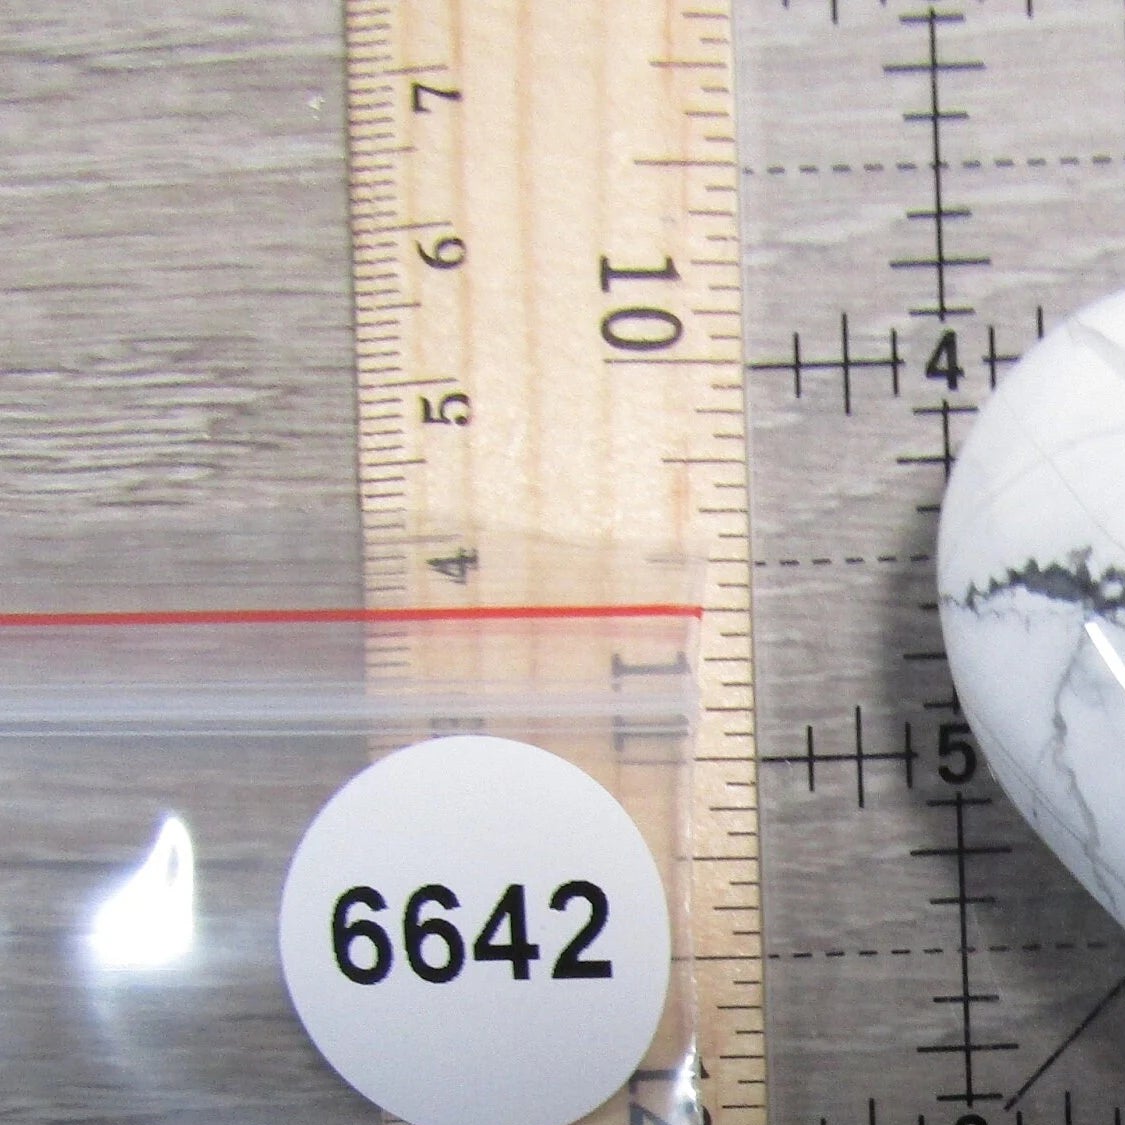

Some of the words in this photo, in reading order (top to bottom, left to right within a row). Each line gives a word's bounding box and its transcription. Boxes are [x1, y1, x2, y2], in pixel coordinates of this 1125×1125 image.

[410, 81, 463, 114] 7
[416, 235, 467, 271] 6
[600, 255, 684, 352] 10
[926, 329, 965, 390] 4
[420, 392, 471, 427] 5
[425, 547, 480, 585] 4
[937, 722, 978, 784] 5
[331, 880, 613, 985] 6642
